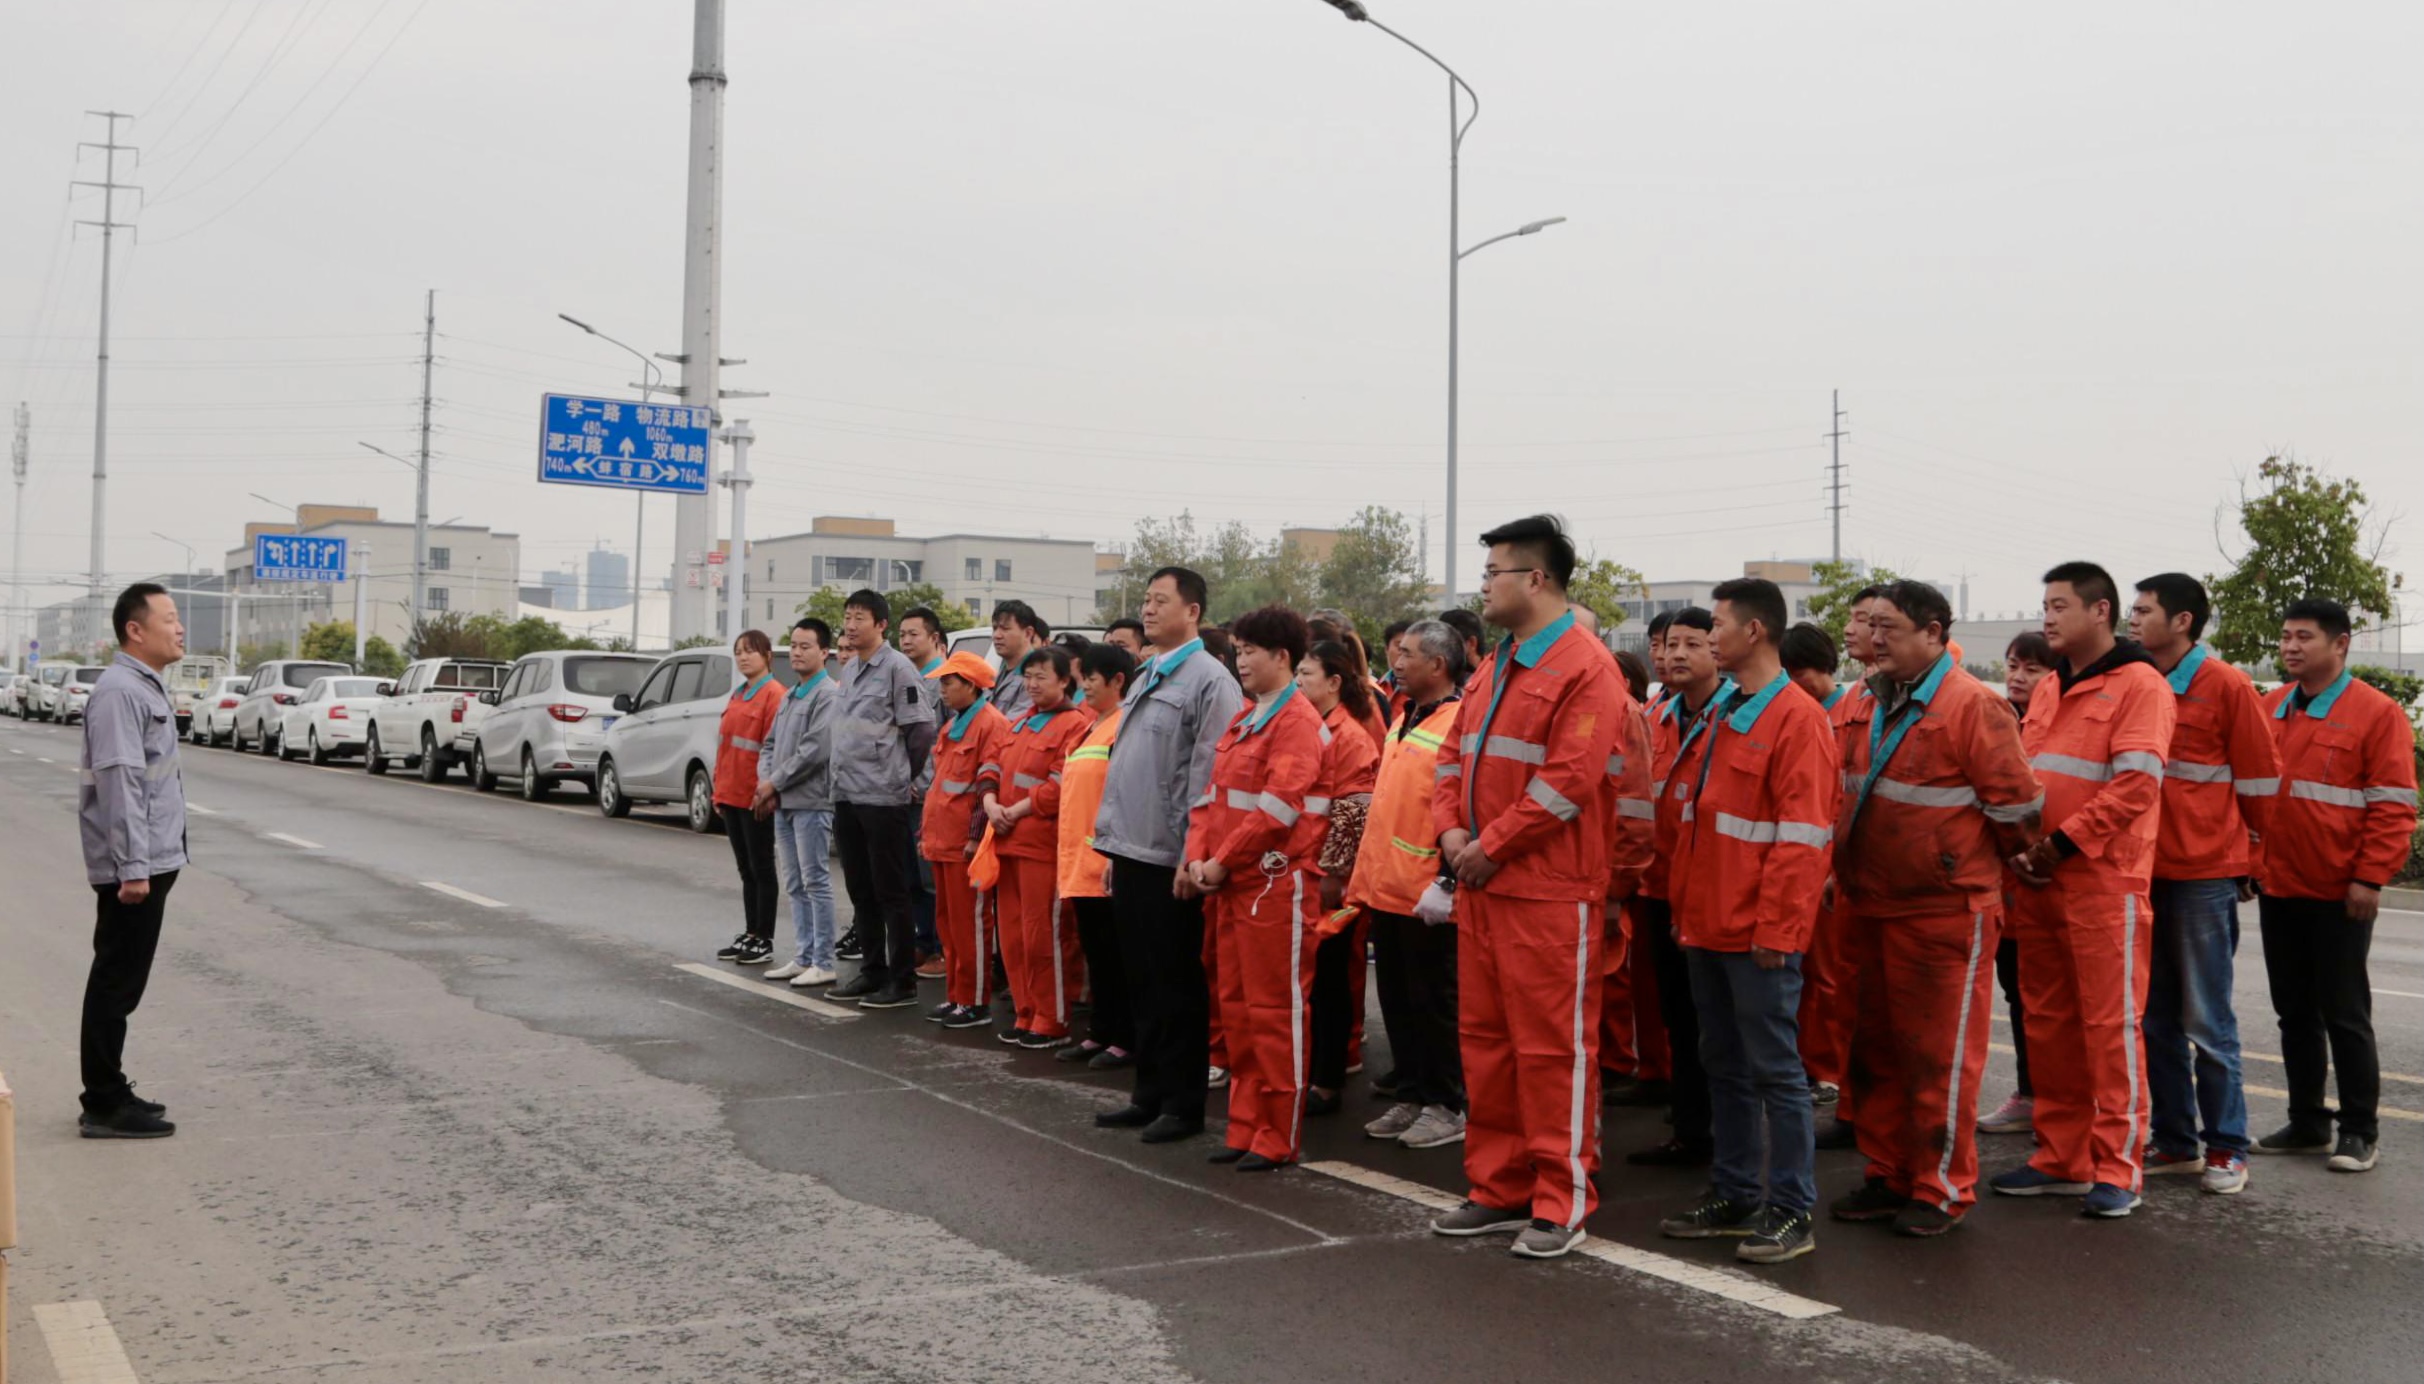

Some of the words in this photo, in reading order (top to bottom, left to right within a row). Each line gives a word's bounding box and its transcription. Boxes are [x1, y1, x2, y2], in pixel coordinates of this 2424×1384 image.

[566, 400, 621, 422] 学一路
[636, 406, 689, 428] 物流路
[582, 420, 609, 436] 480m
[647, 427, 673, 442] 1060m
[652, 442, 704, 464] 双墩路
[545, 456, 572, 472] 740m
[679, 468, 705, 483] 760m
